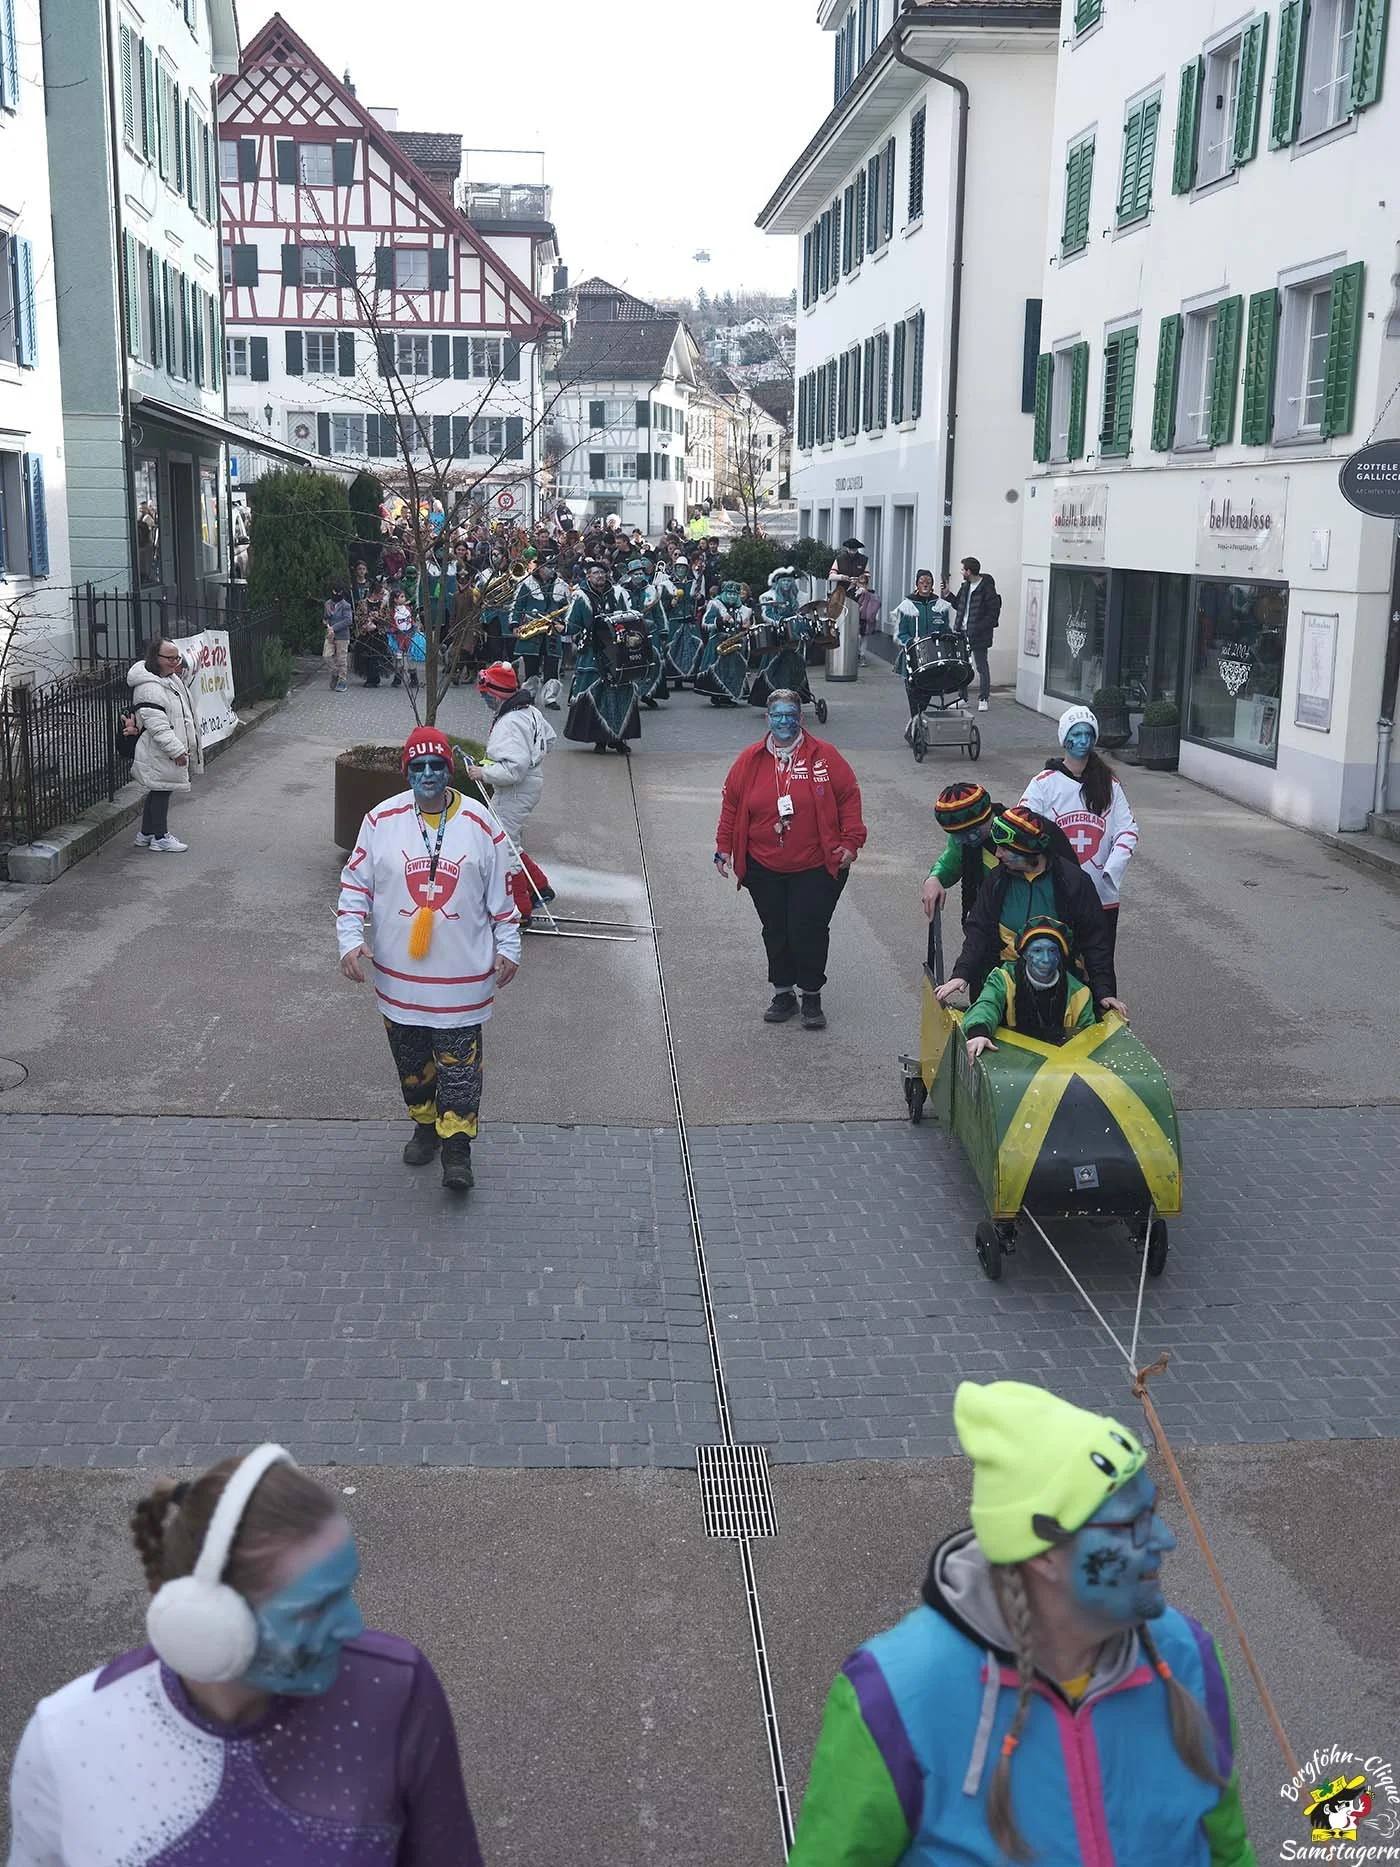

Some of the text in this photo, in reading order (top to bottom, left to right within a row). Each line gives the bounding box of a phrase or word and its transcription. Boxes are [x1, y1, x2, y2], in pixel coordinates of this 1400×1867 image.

[1356, 463, 1398, 471] ZOTTELE
[1209, 498, 1271, 530] bellenaisse
[1057, 813, 1105, 828] SWITZERLAND
